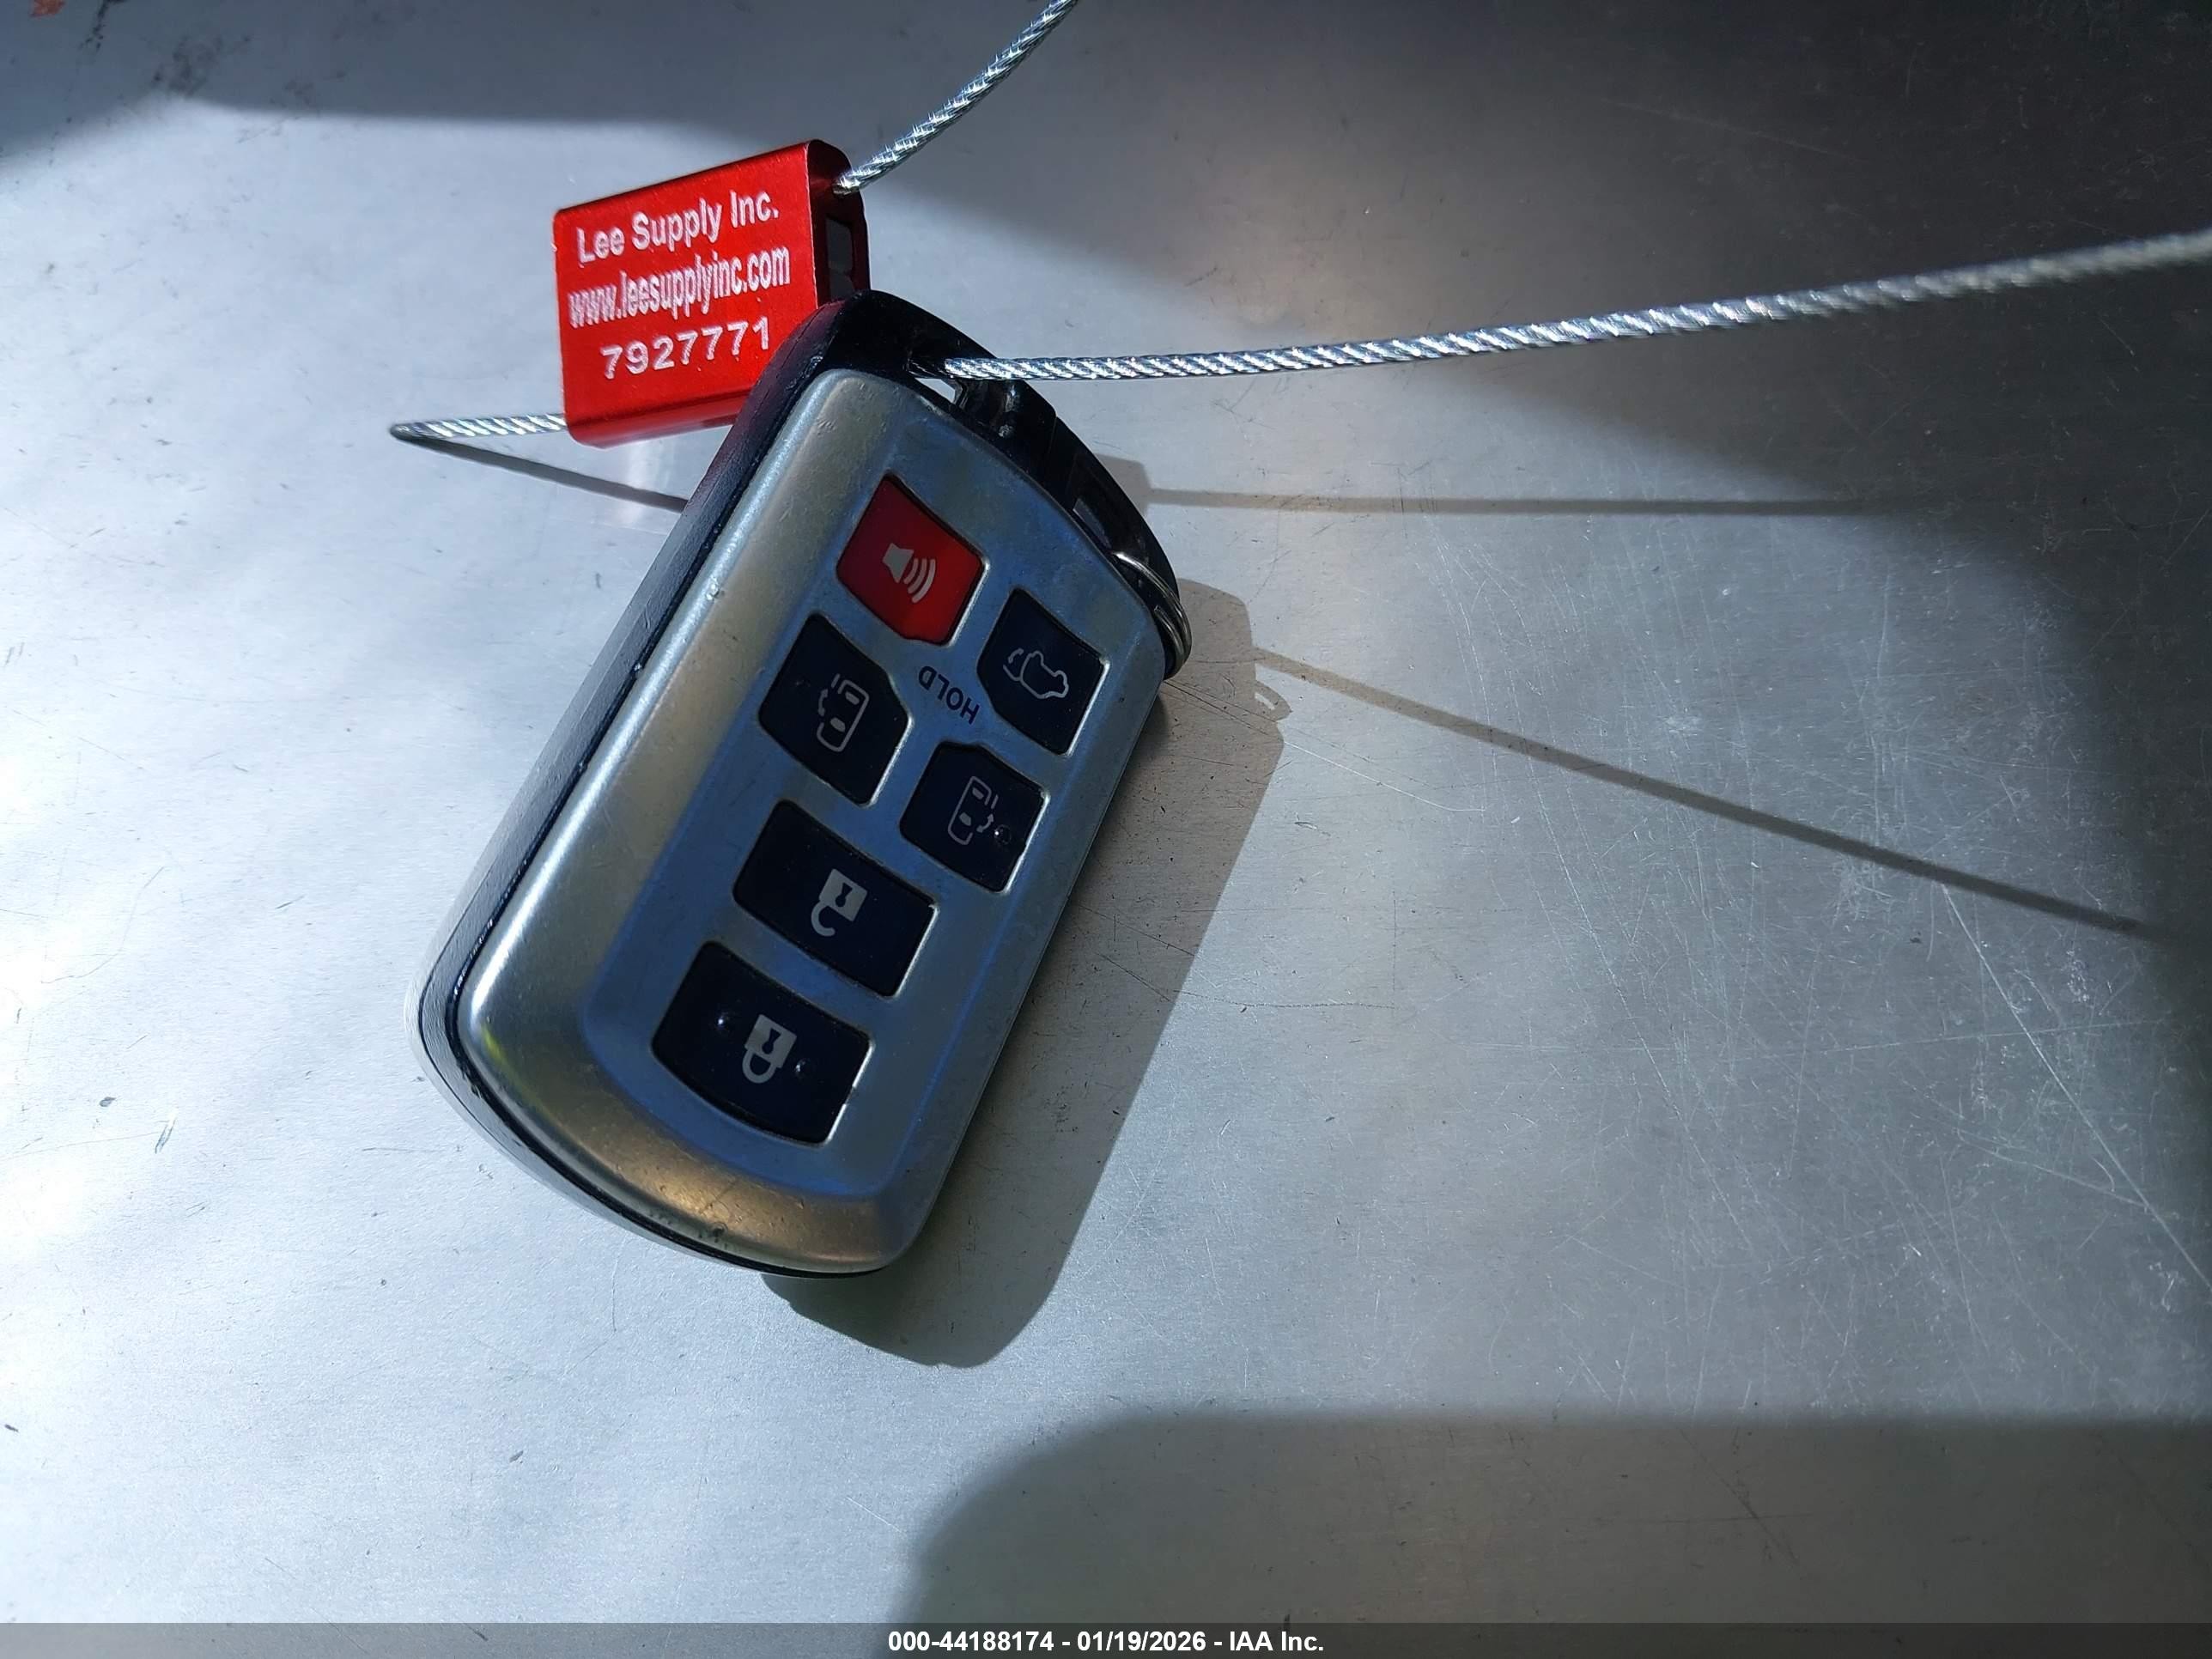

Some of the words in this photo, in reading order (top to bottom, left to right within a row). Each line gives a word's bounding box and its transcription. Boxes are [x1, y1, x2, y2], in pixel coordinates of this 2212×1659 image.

[576, 226, 625, 265] Lee
[632, 197, 723, 252] Supply
[729, 189, 780, 228] Inc.
[568, 245, 792, 329] www.leesupplyinc.com
[601, 315, 770, 380] 7927771
[918, 665, 981, 725] HOLD
